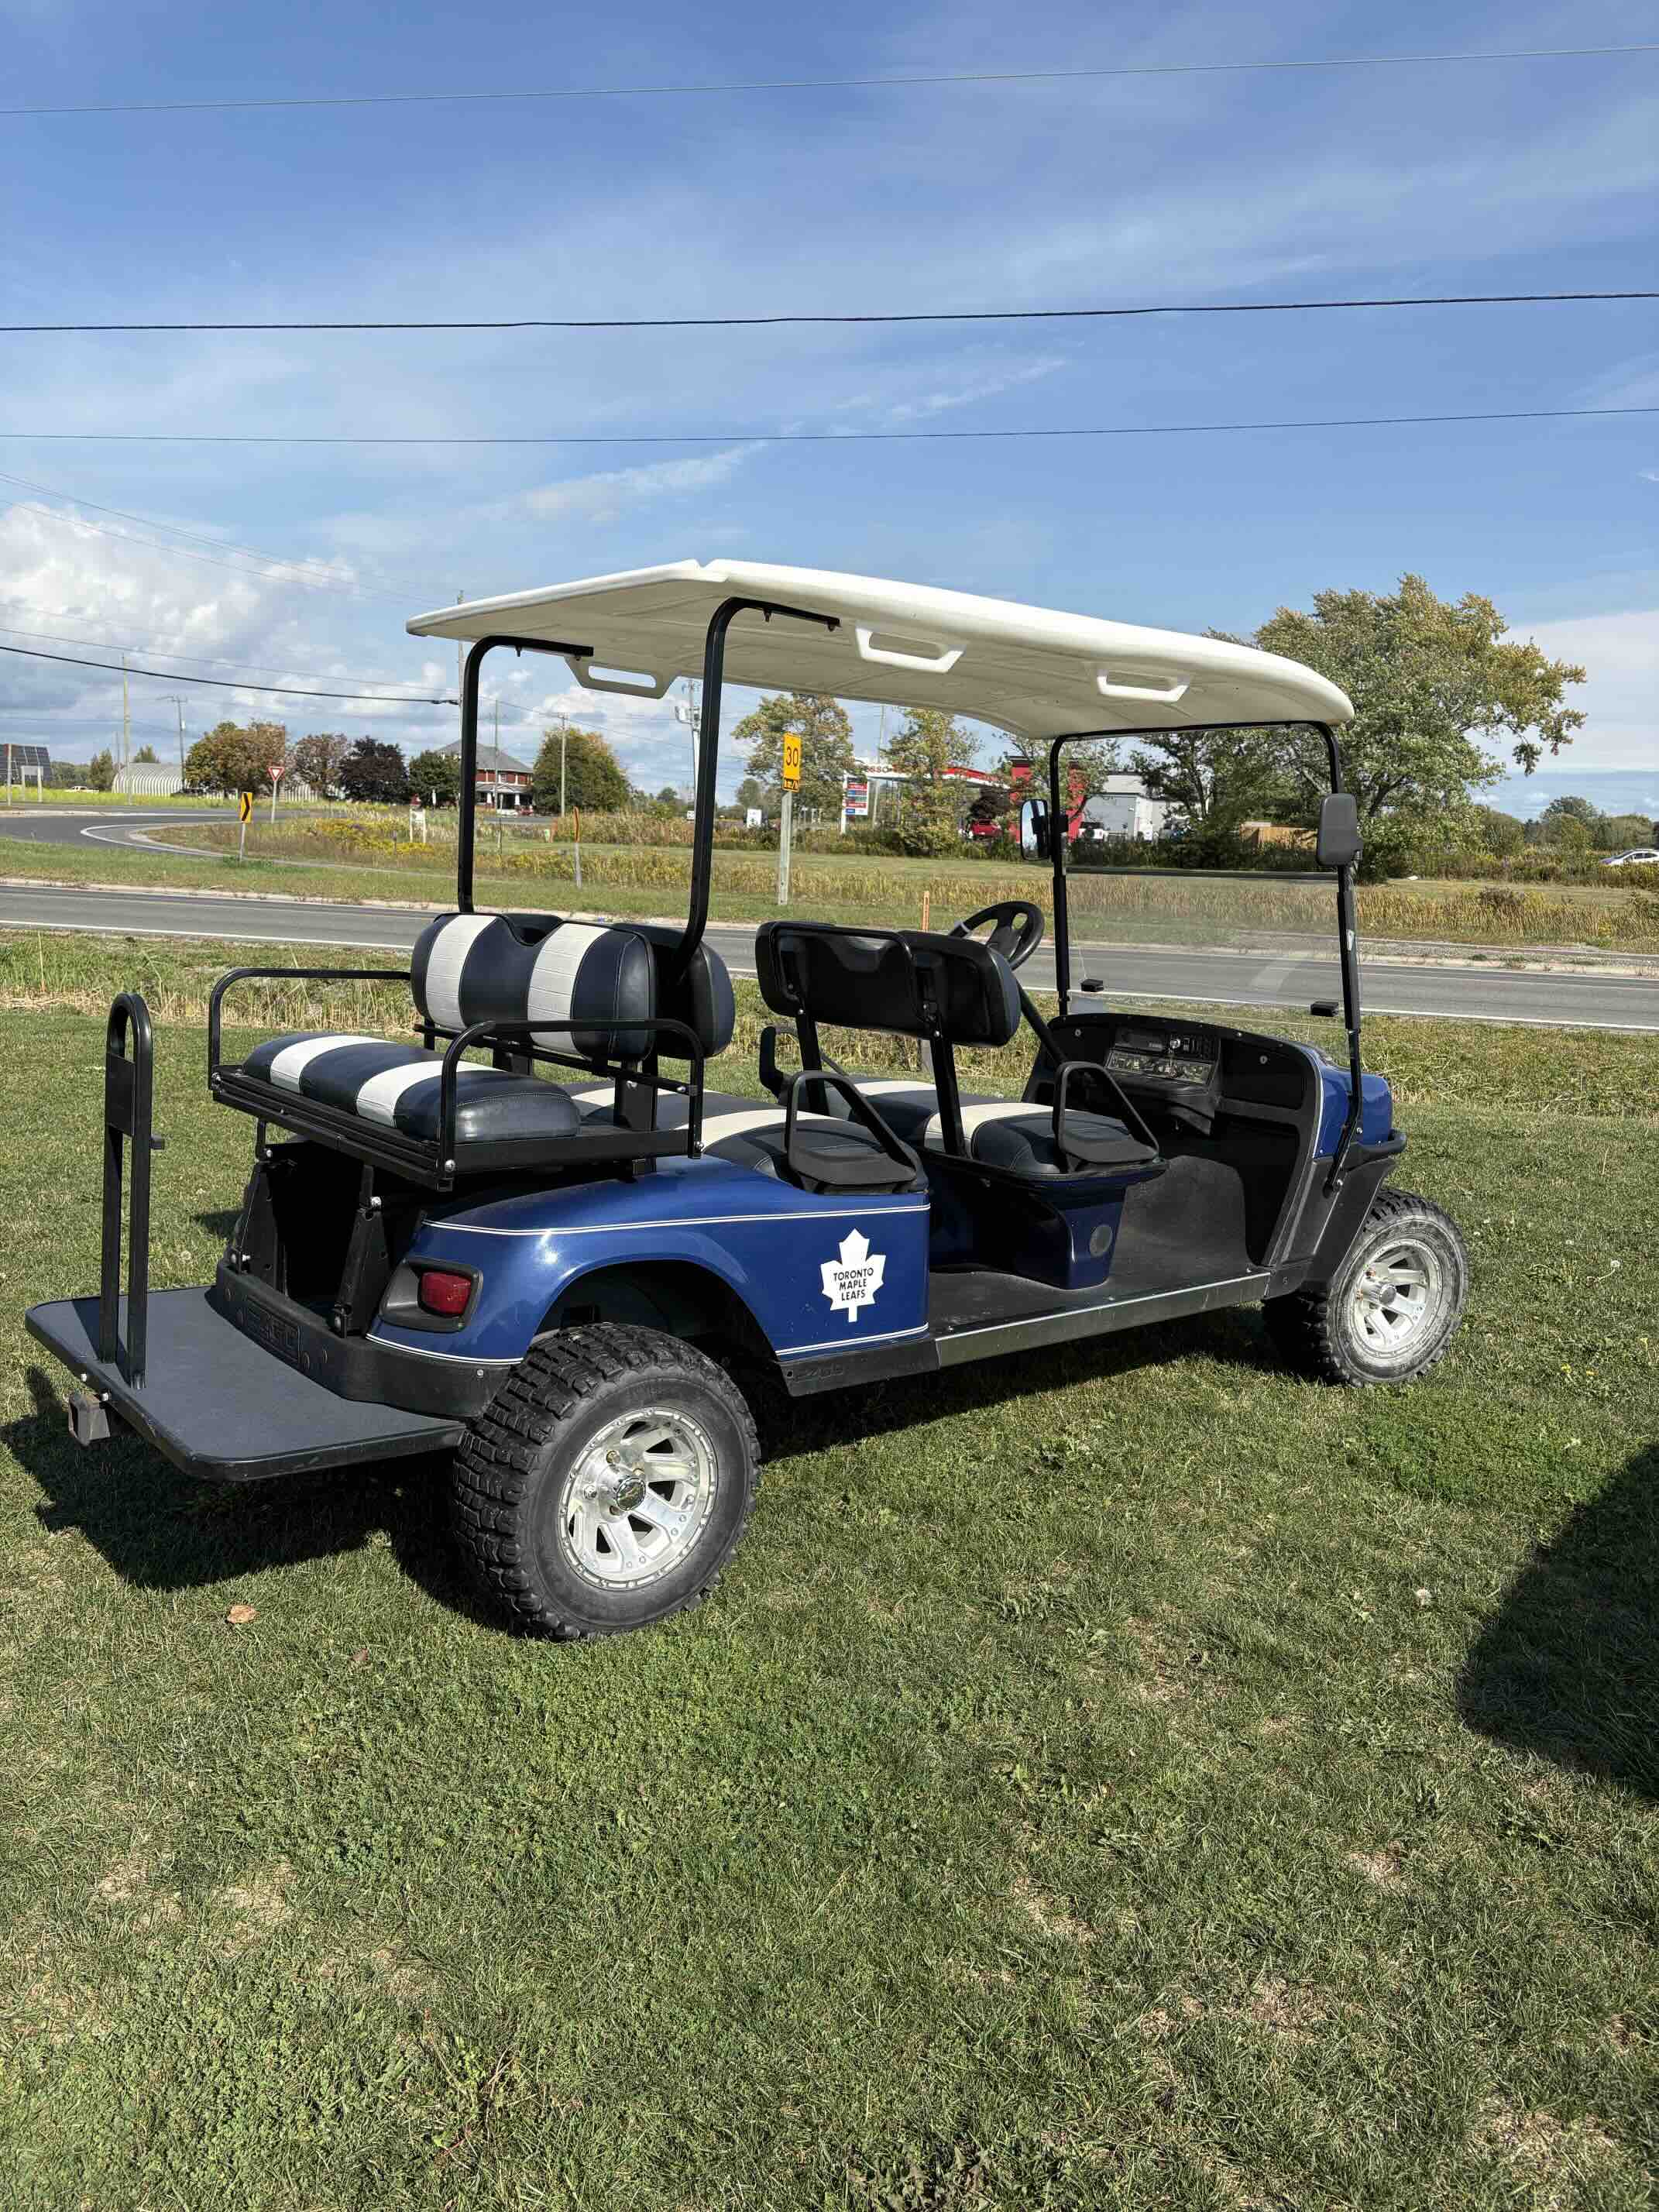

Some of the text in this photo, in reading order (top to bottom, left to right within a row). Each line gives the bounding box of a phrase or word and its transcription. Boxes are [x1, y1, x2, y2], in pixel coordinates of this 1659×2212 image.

[786, 746, 799, 767] 30
[833, 1267, 874, 1282] TORONTO
[839, 1278, 867, 1290] MAPLE
[841, 1289, 866, 1301] LEAFS
